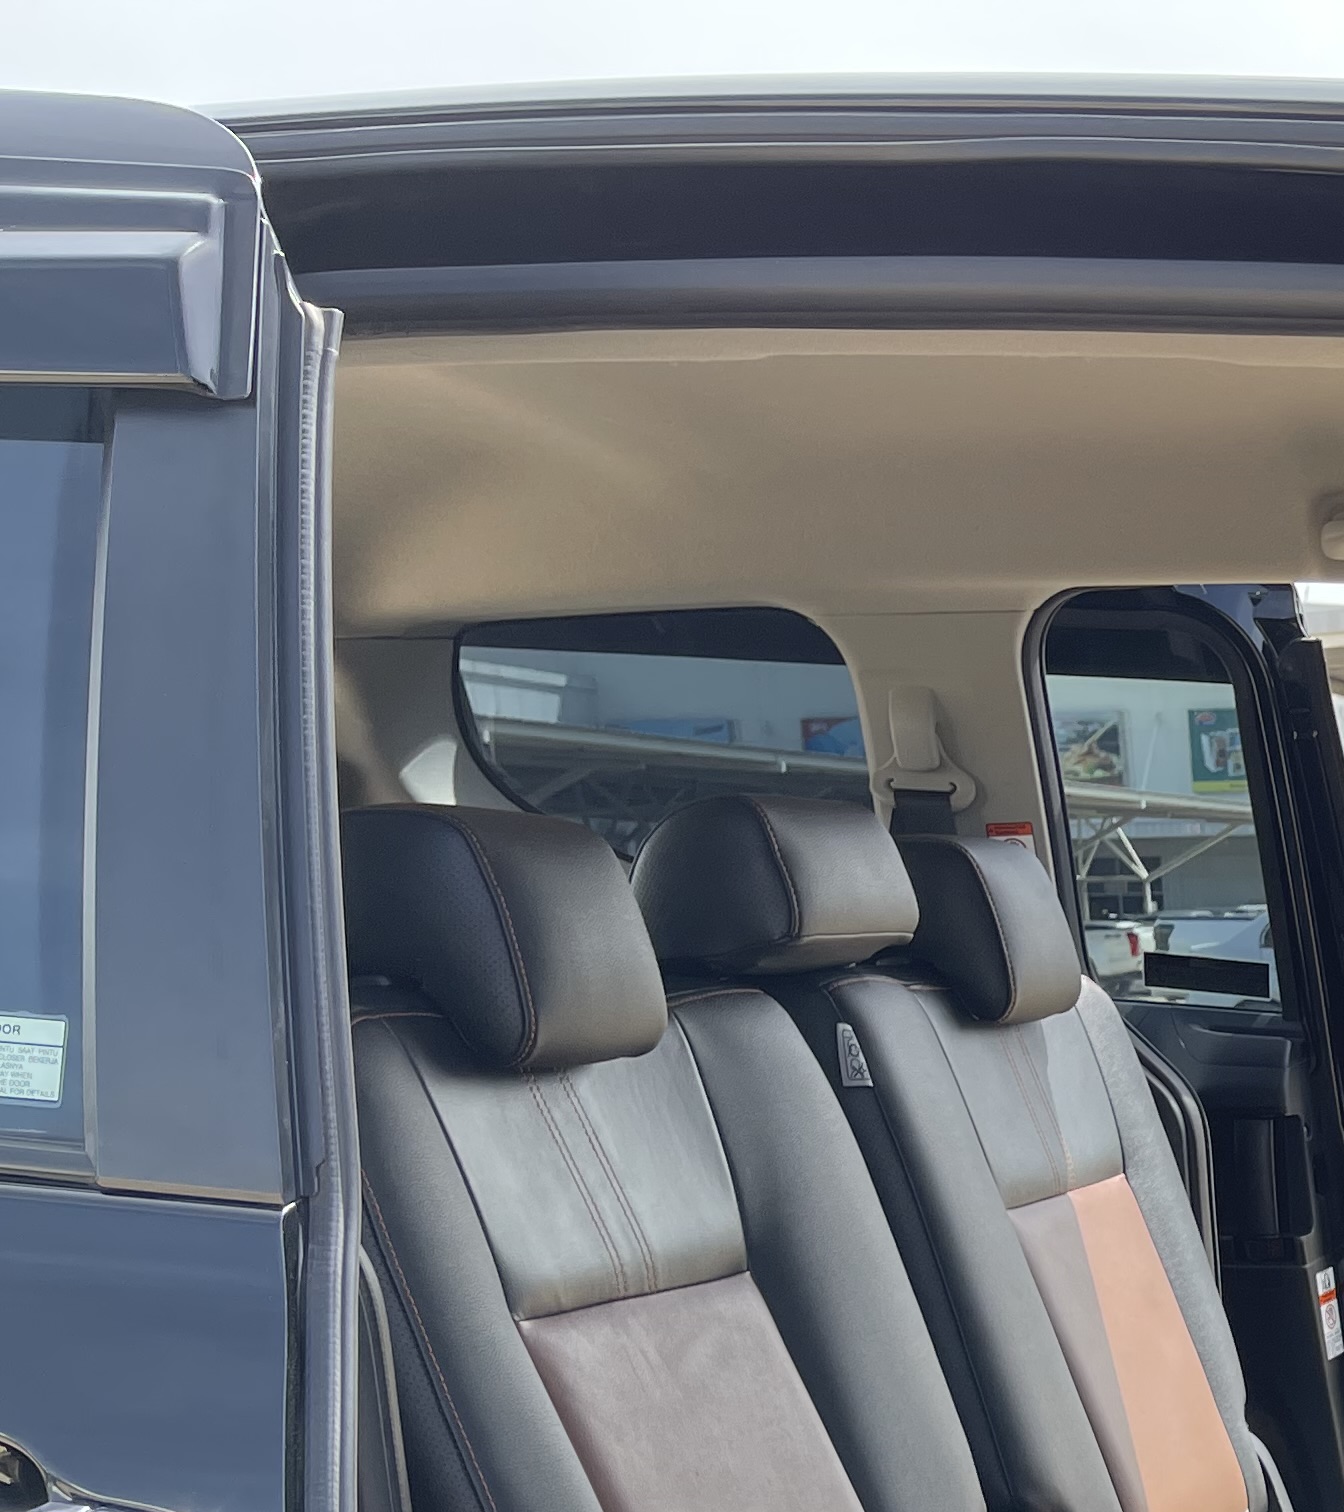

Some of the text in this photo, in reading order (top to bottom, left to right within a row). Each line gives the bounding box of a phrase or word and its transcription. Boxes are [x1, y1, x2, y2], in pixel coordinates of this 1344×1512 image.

[38, 1048, 59, 1057] PINTU
[28, 1056, 59, 1065] BEKERJA
[10, 1071, 33, 1080] WHEN
[9, 1079, 31, 1087] DOOR
[10, 1088, 25, 1096] FOR
[26, 1089, 55, 1098] DETAILS
